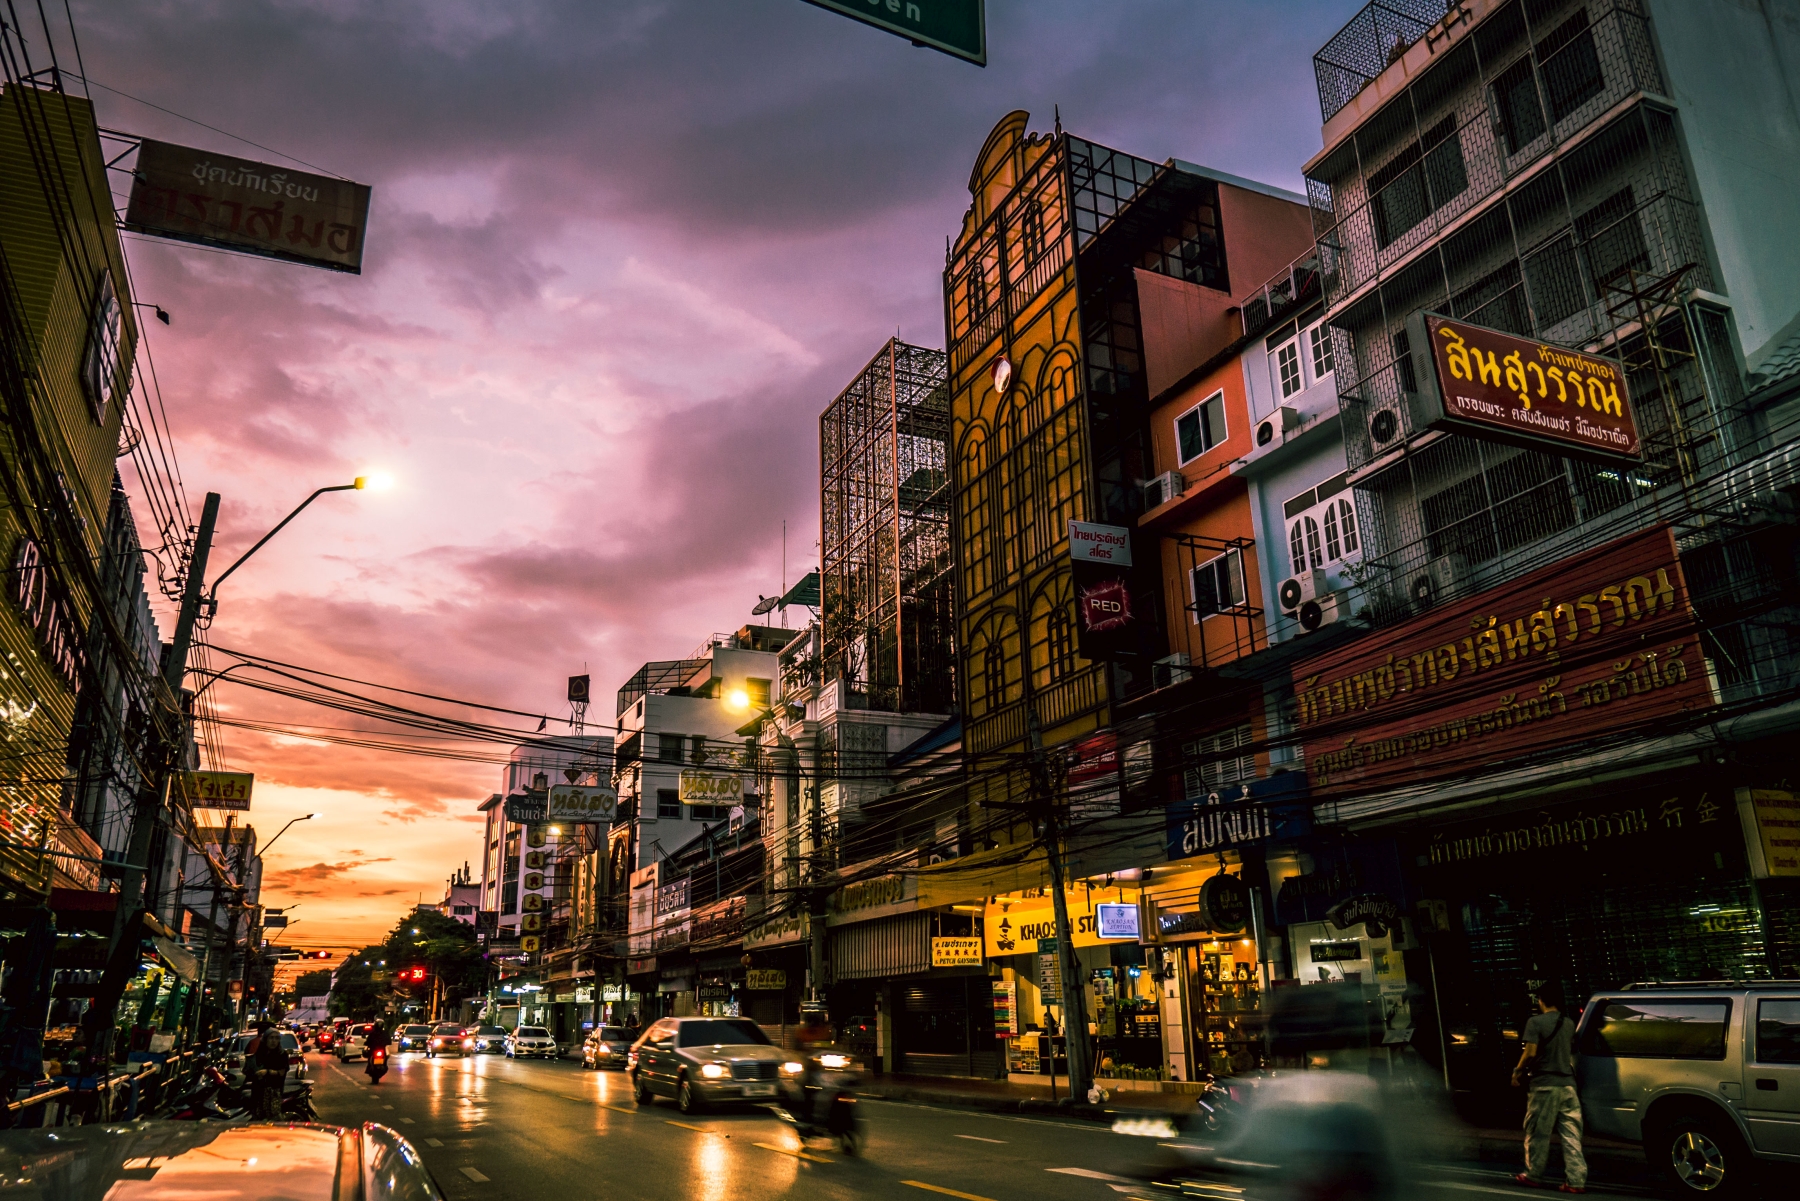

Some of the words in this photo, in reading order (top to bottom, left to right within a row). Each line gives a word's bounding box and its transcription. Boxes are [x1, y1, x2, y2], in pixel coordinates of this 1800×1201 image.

[867, 0, 921, 22] en
[192, 161, 319, 202] ชุดนักเรียน
[137, 186, 358, 254] ตราสมอ
[1439, 327, 1622, 417] สินสุวรรณ
[1537, 344, 1615, 380] ห้างเพชรทอง
[1457, 396, 1505, 418] กรอบพระ
[1512, 408, 1571, 432] ตลับฝังเพชร
[1071, 525, 1126, 549] ไทยประดิษฐ์
[1089, 544, 1113, 559] สโตร์
[1091, 599, 1121, 613] RED
[1298, 567, 1675, 724] ห้างเพชรทองสินสุวรรณ
[1574, 644, 1688, 707] รอรับได้
[553, 789, 614, 811] หลีเสง
[1020, 918, 1074, 941] KHAOS
[1106, 918, 1136, 926] KHAOSAN
[413, 969, 423, 979] 30
[749, 969, 785, 983] หลีเสง
